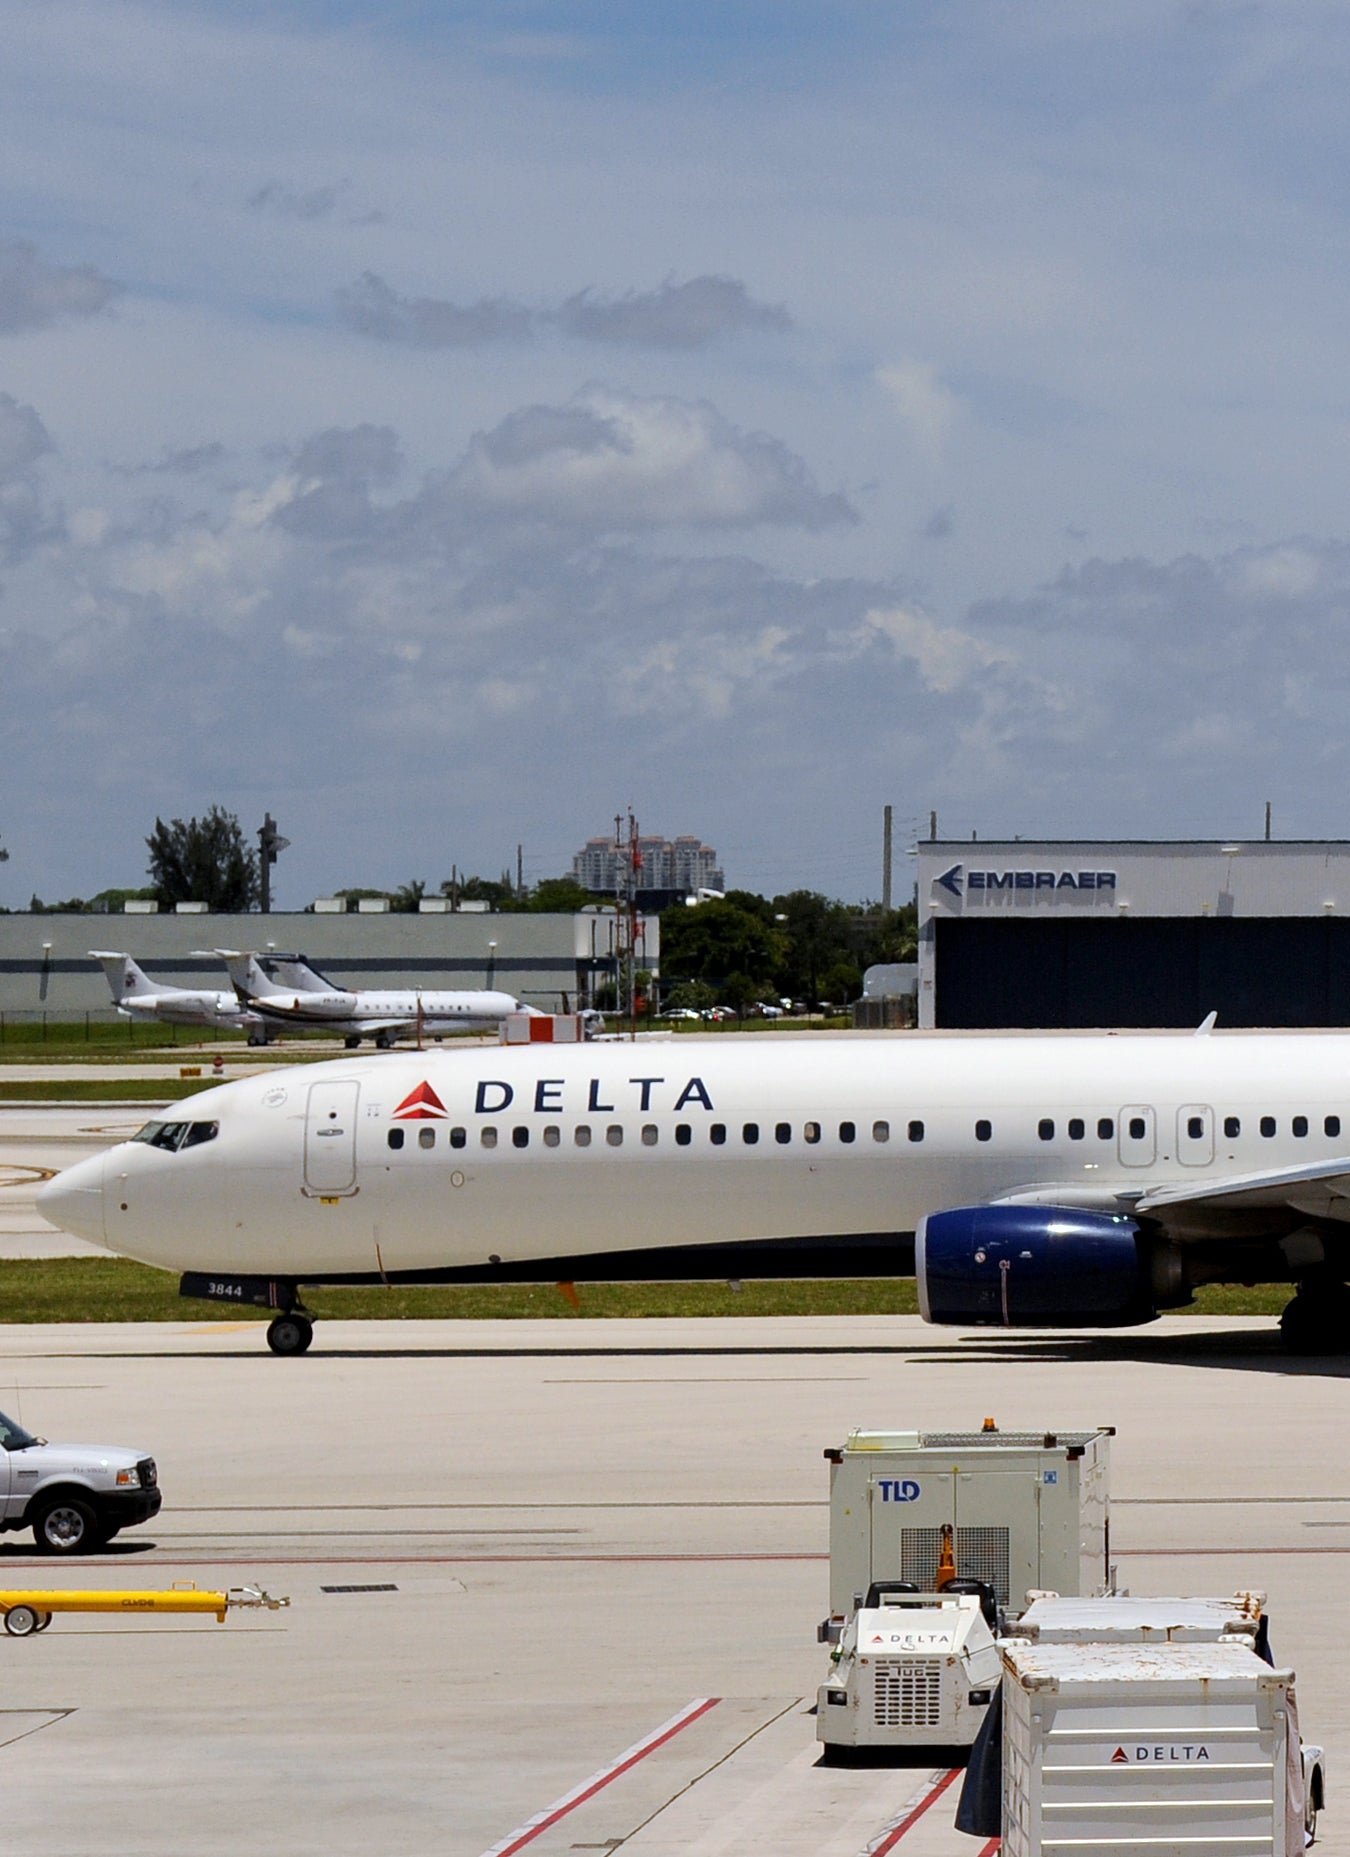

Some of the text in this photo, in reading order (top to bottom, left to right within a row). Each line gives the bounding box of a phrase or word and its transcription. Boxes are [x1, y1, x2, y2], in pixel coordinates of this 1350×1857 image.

[968, 872, 1116, 889] EMBRAER
[475, 1077, 714, 1113] DELTA
[208, 1282, 242, 1296] 3844
[878, 1480, 920, 1502] TLD
[891, 1666, 924, 1677] TUG
[1136, 1746, 1209, 1760] DELTA
